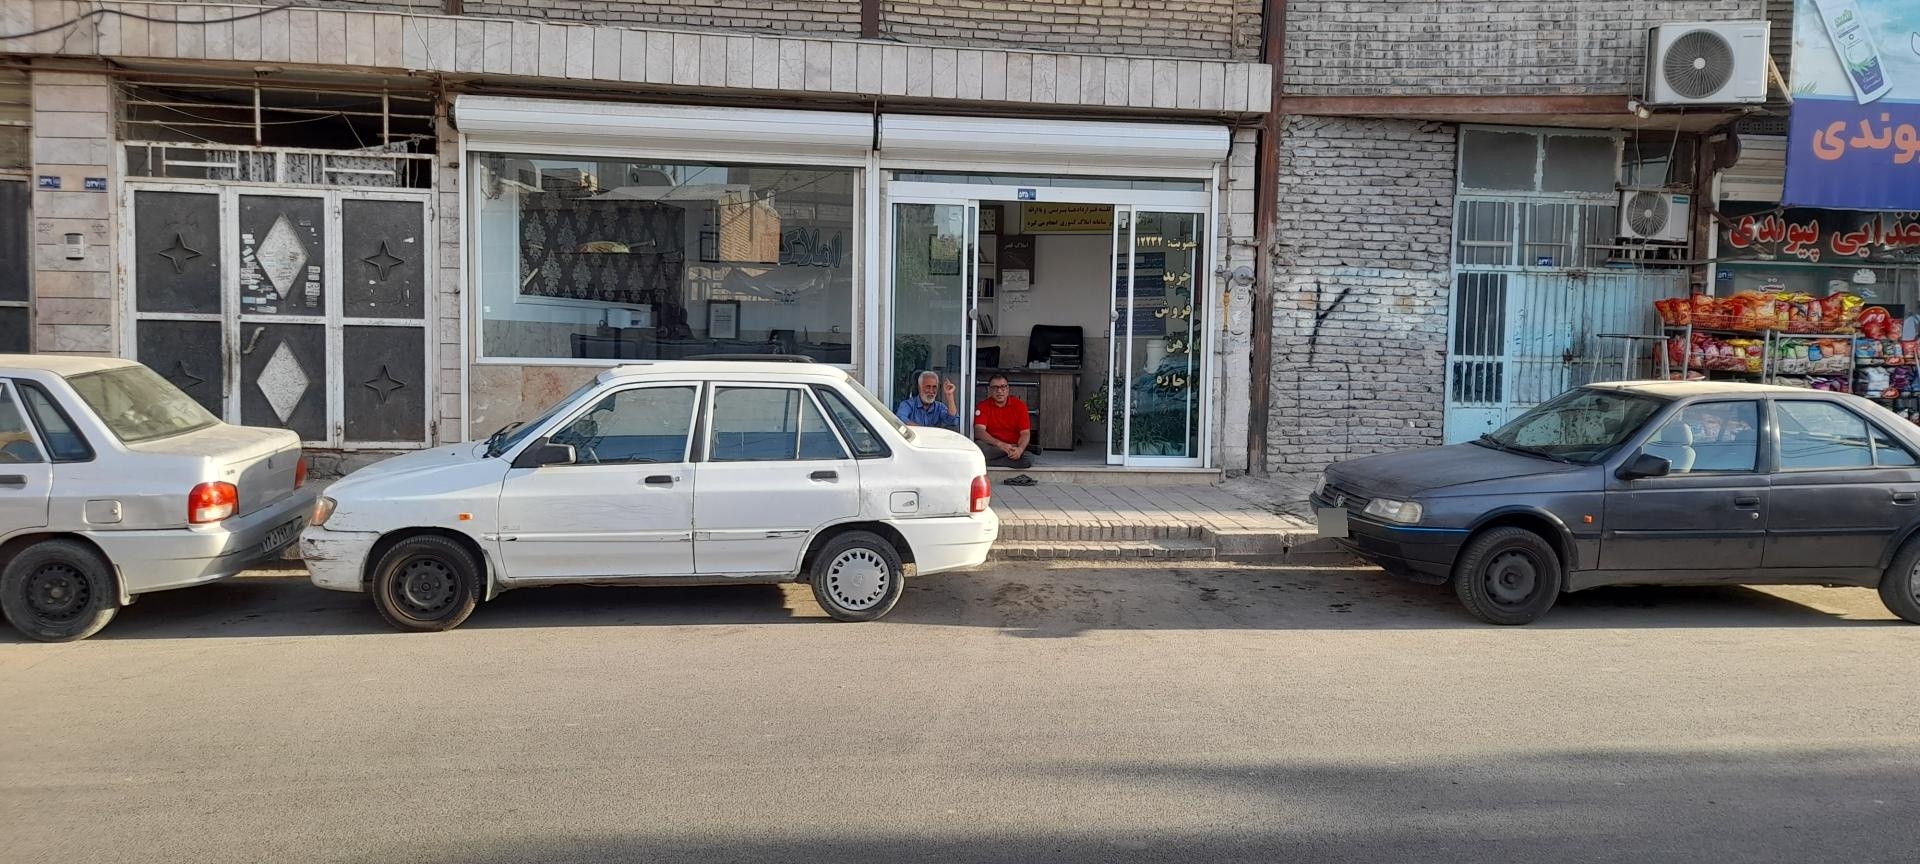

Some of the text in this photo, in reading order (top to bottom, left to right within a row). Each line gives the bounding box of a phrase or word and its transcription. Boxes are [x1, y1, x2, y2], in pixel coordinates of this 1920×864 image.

[1812, 112, 1920, 165] وندی
[1729, 206, 1821, 262] پیوندی
[1162, 267, 1192, 288] خرید
[1154, 300, 1192, 319] فروش
[1166, 338, 1192, 354] رهن
[1156, 374, 1192, 392] اجاره
